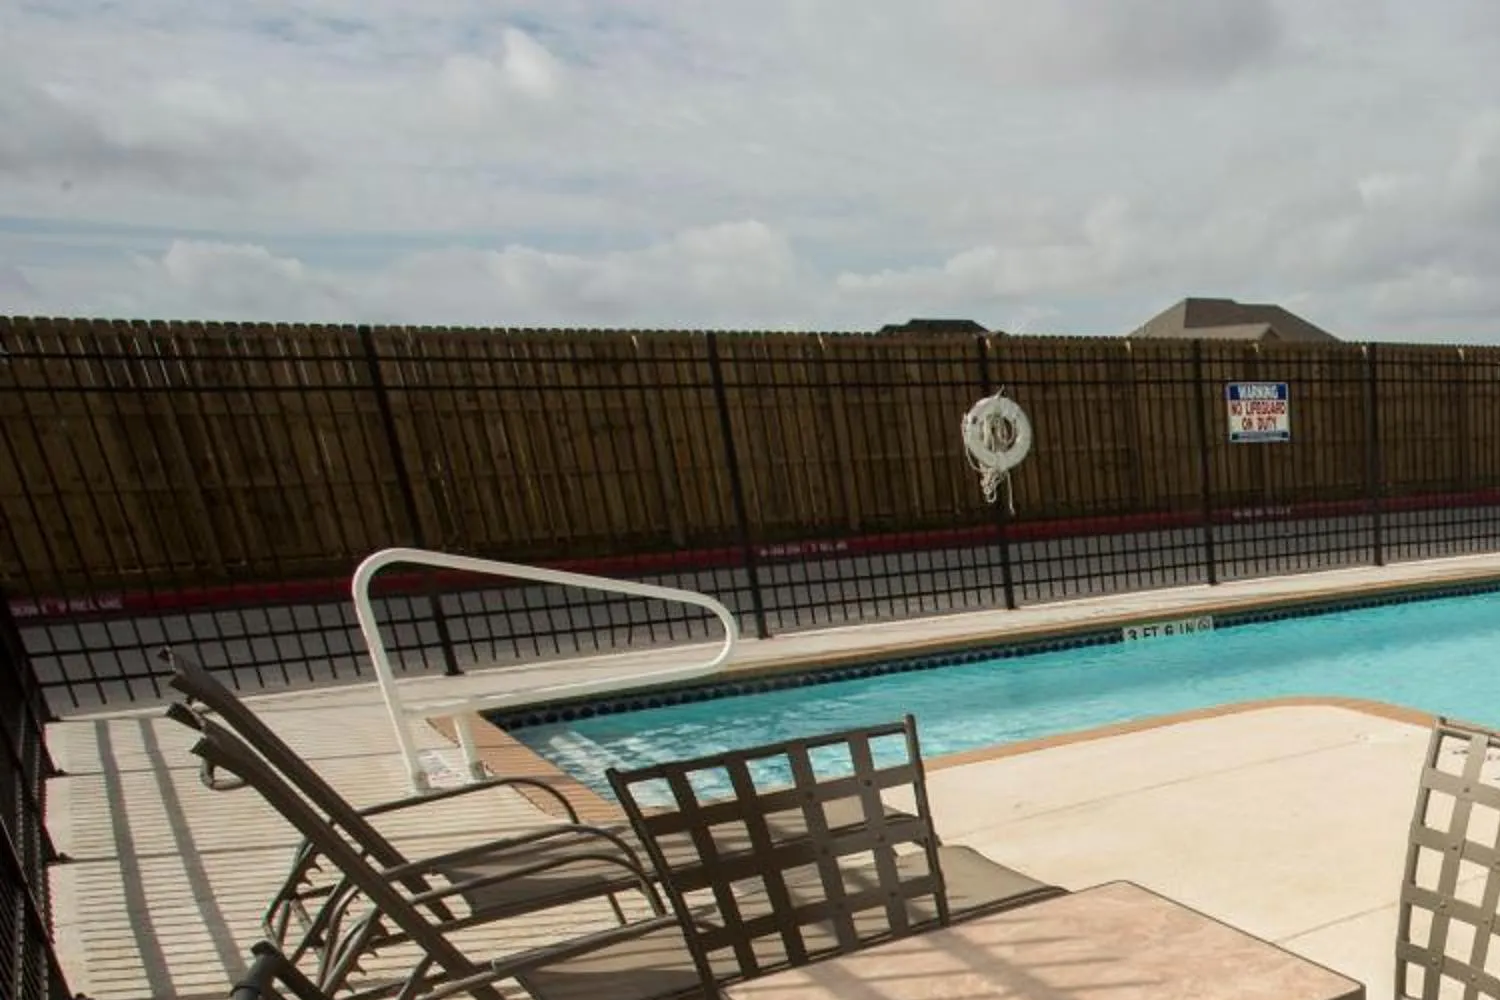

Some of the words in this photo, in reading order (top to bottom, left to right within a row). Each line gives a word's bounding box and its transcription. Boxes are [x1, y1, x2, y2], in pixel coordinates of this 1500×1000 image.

[1230, 402, 1242, 415] NO
[1245, 401, 1285, 415] LIFEGUARD
[1143, 626, 1159, 638] FT
